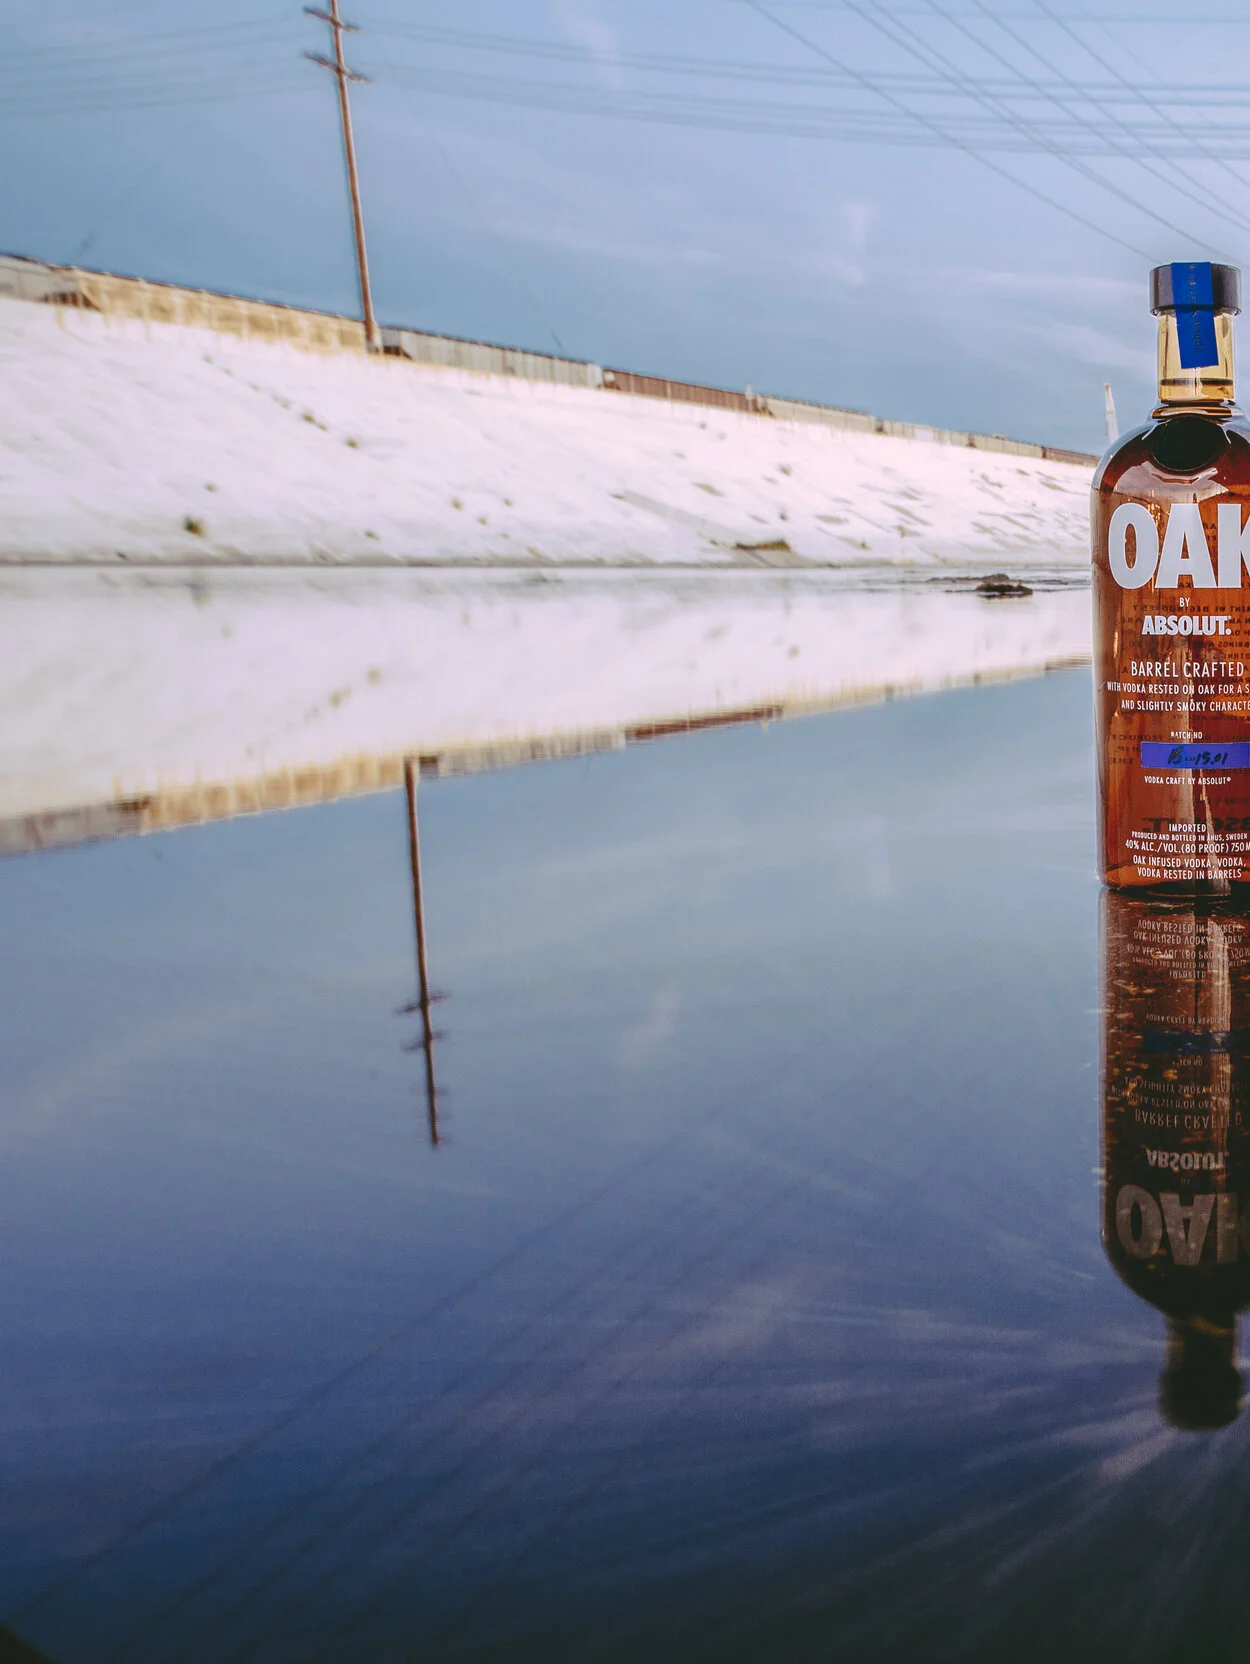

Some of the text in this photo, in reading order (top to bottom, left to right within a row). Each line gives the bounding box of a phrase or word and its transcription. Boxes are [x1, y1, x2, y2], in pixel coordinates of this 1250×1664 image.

[1179, 597, 1190, 607] BY
[1131, 661, 1244, 678] BARREL CRAFTED
[1106, 681, 1121, 692] WITH
[1122, 683, 1146, 694] VODKA
[1149, 684, 1178, 695] RESTED
[1182, 684, 1194, 695] ON
[1198, 684, 1215, 695] OAK
[1218, 683, 1234, 694] FOR
[1237, 683, 1243, 694] A
[1121, 700, 1135, 710] AND
[1137, 701, 1174, 712] SLIGHTLY
[1176, 701, 1206, 712] SMOKY
[1193, 731, 1203, 739] NO
[1144, 776, 1164, 784] VODKA
[1165, 776, 1185, 785] CRAFT
[1187, 776, 1196, 785] BY
[1168, 823, 1207, 833] IMPORTED
[1131, 831, 1157, 840] PRODUCED
[1158, 833, 1170, 841] AND
[1171, 834, 1196, 842] BOTTLED
[1198, 834, 1205, 842] IN
[1225, 832, 1248, 841] SWEDEN
[1125, 839, 1139, 850] 40%
[1132, 854, 1146, 865] OAK
[1148, 856, 1181, 868] INFUSED
[1137, 867, 1242, 880] VODKA RESTED IN BARRELS
